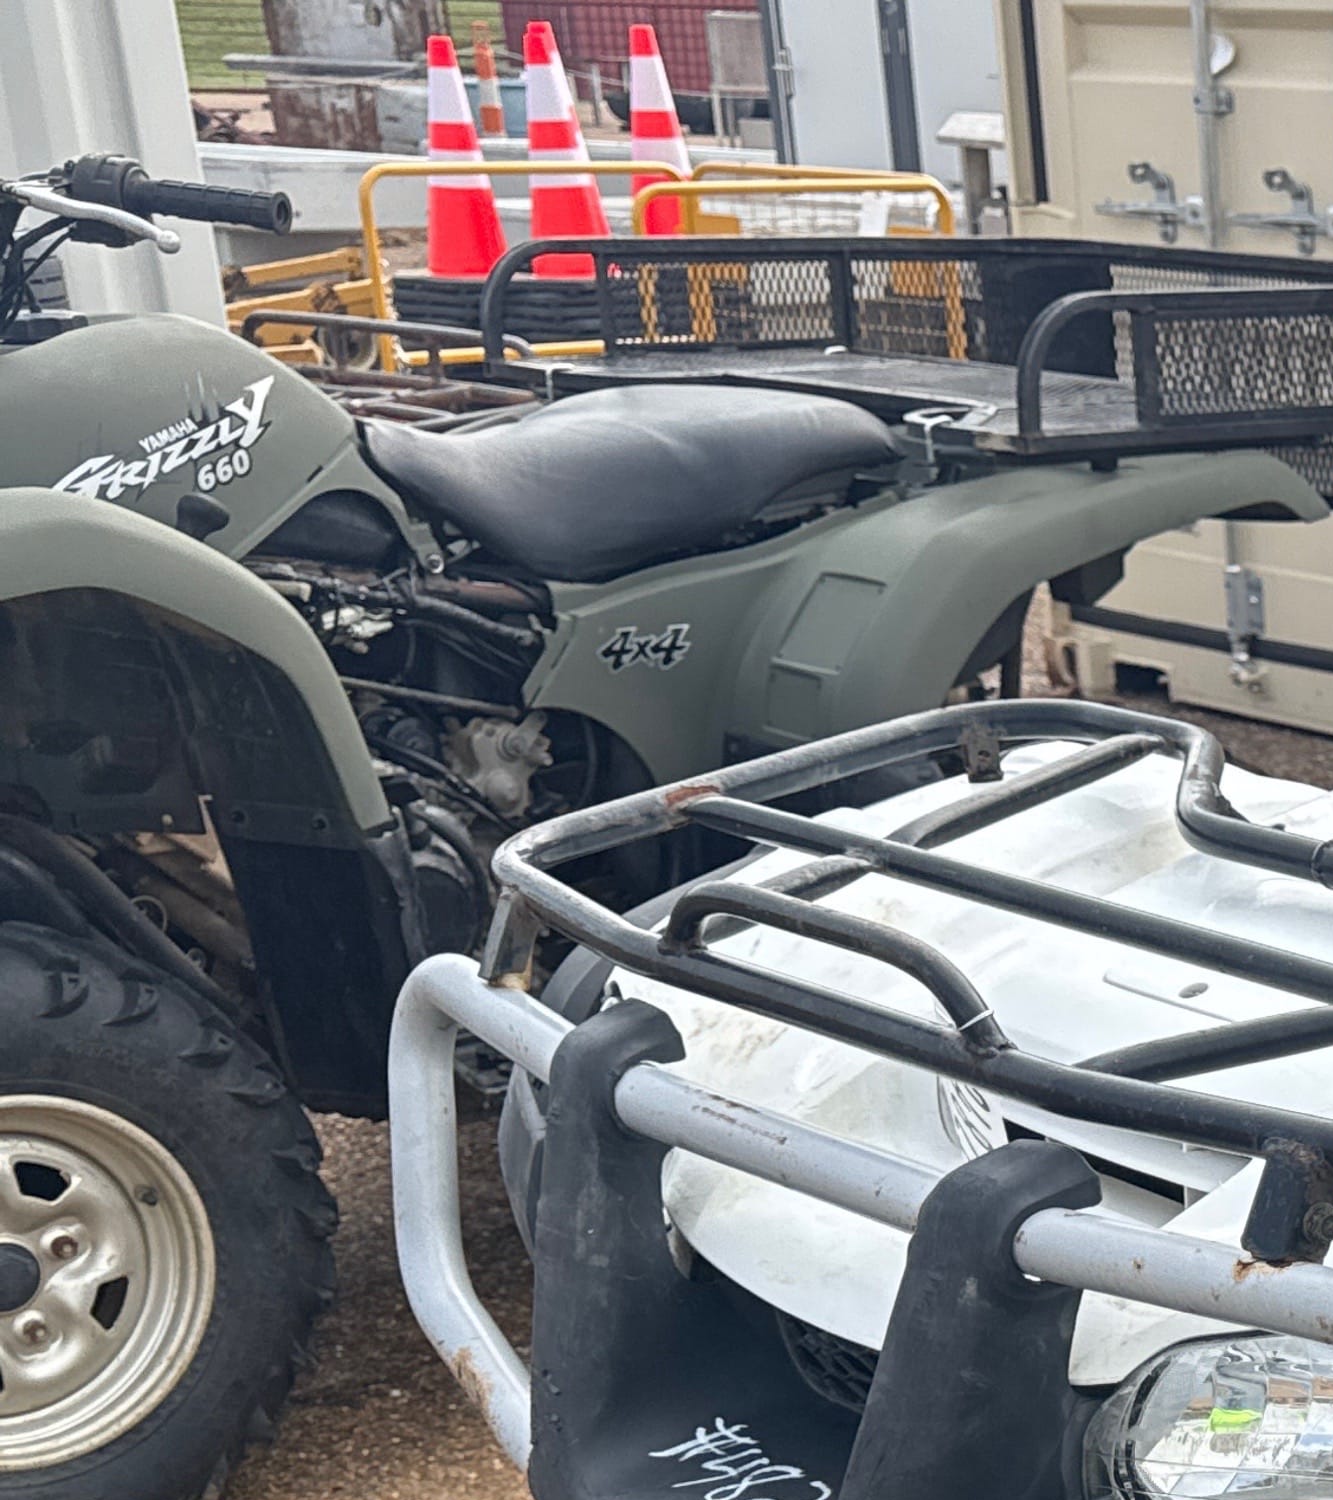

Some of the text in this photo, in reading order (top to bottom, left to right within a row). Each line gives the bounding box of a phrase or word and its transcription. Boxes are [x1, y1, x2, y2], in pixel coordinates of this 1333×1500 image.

[52, 375, 275, 500] GRIZZLY
[138, 417, 199, 453] YAMAHA
[197, 448, 253, 492] 660
